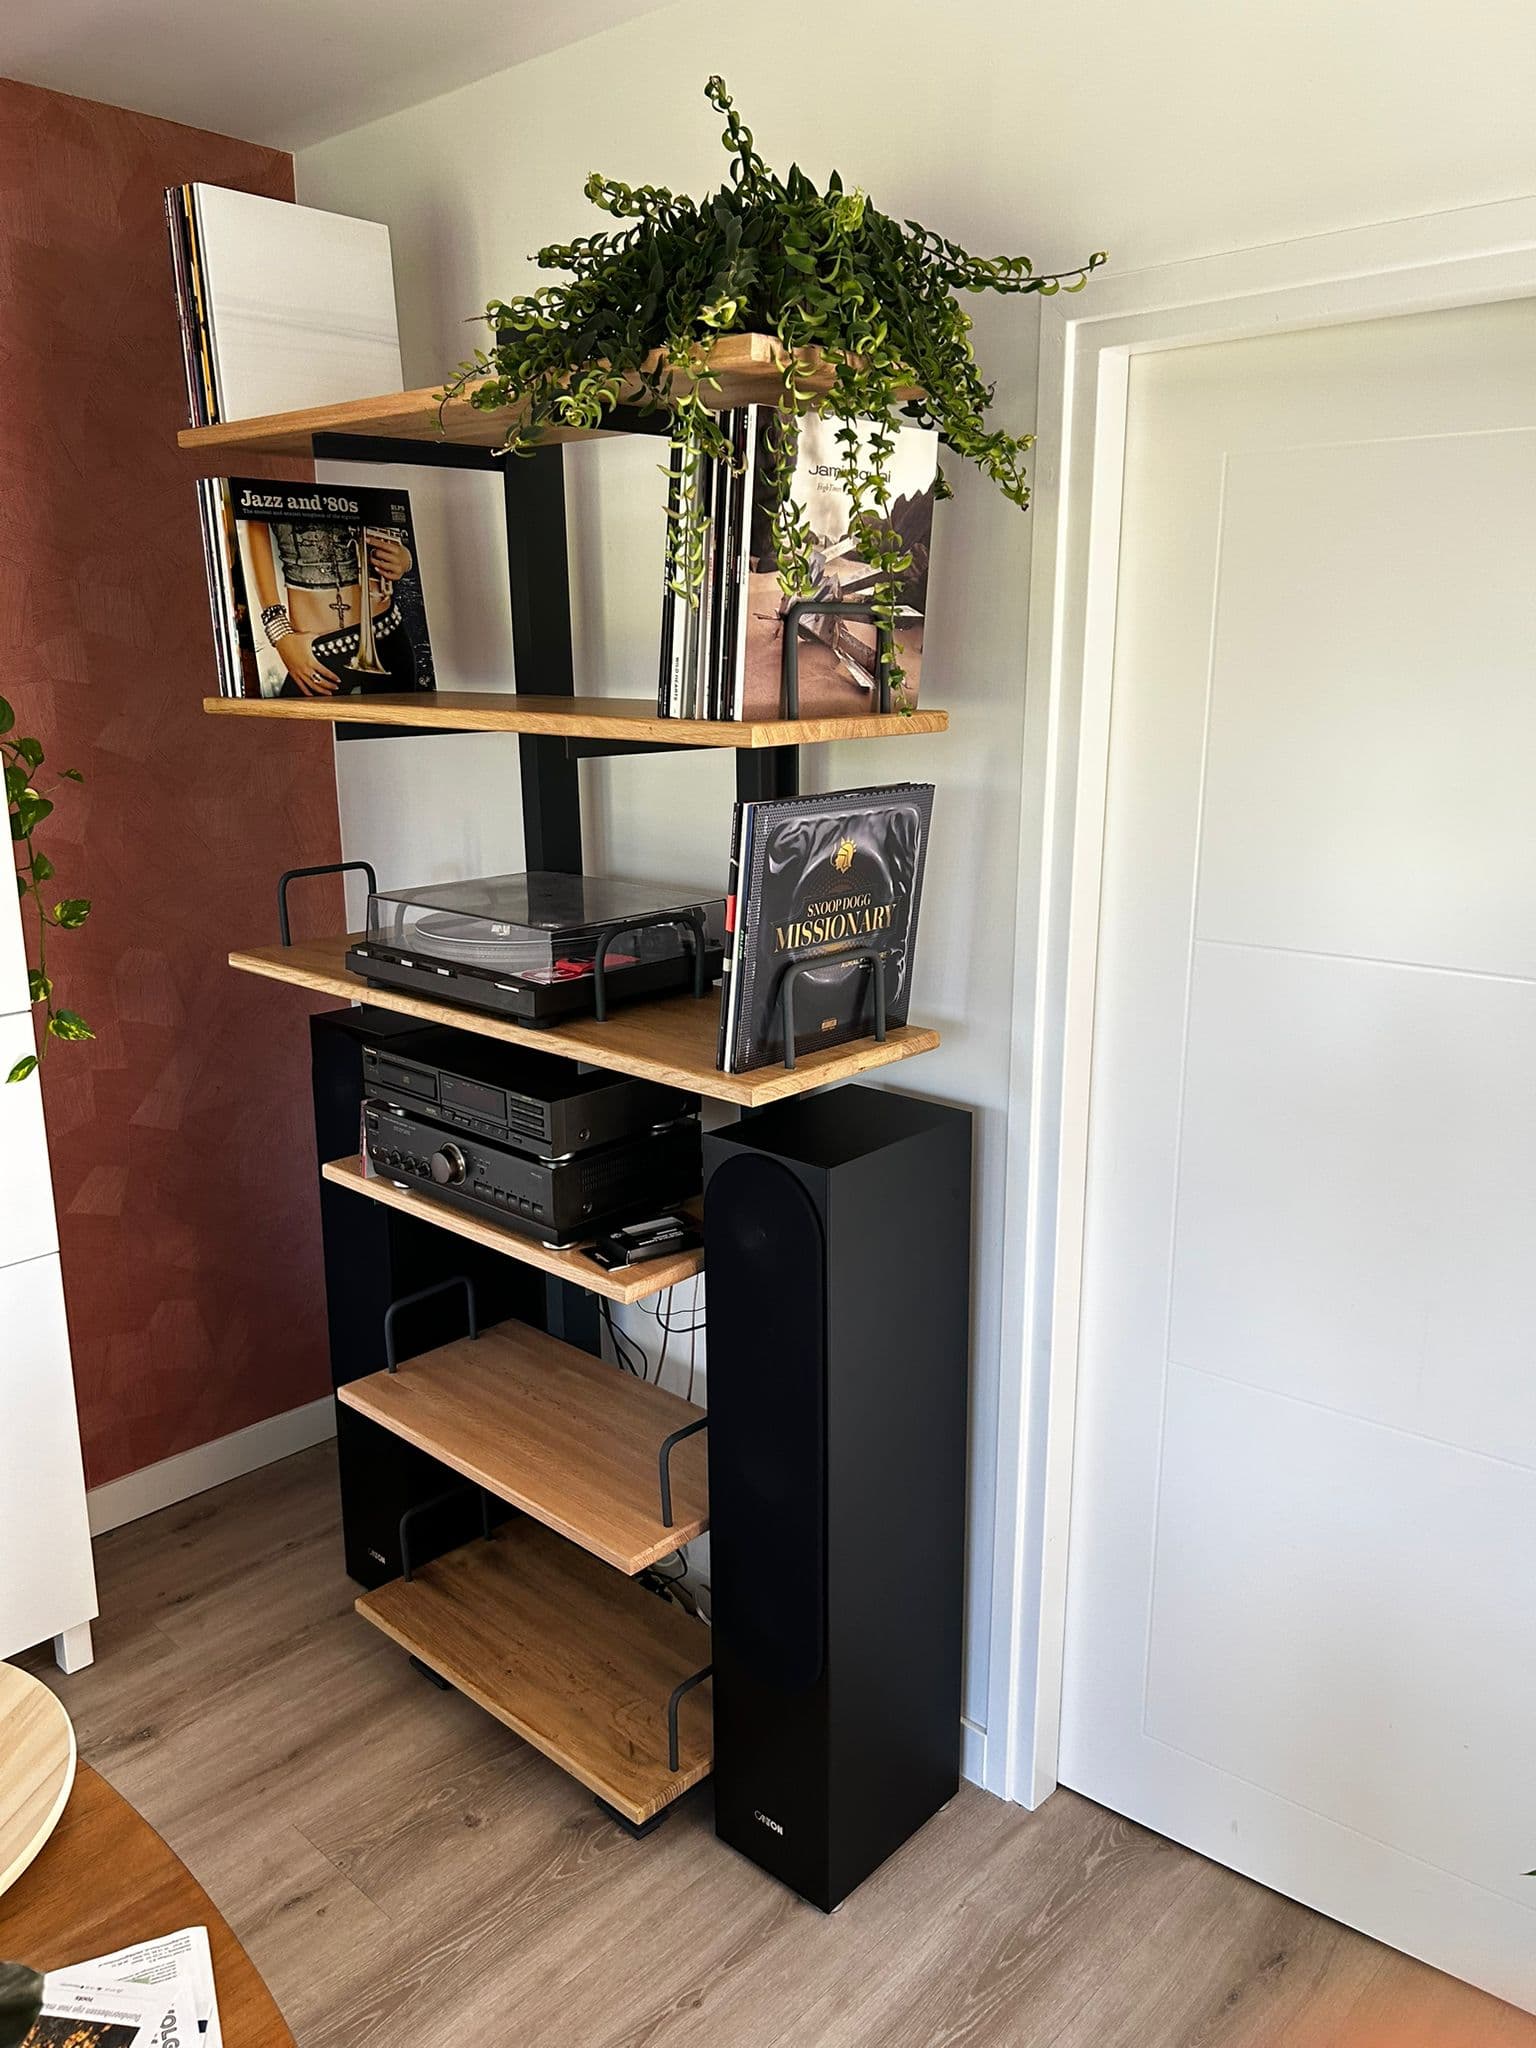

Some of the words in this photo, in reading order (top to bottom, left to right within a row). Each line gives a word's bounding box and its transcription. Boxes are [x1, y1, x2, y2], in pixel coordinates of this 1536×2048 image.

[240, 490, 283, 508] Jazz
[287, 494, 323, 511] and
[807, 899, 842, 918] SNOOP
[842, 893, 871, 910] DOGG
[774, 904, 897, 953] MISSIONARY
